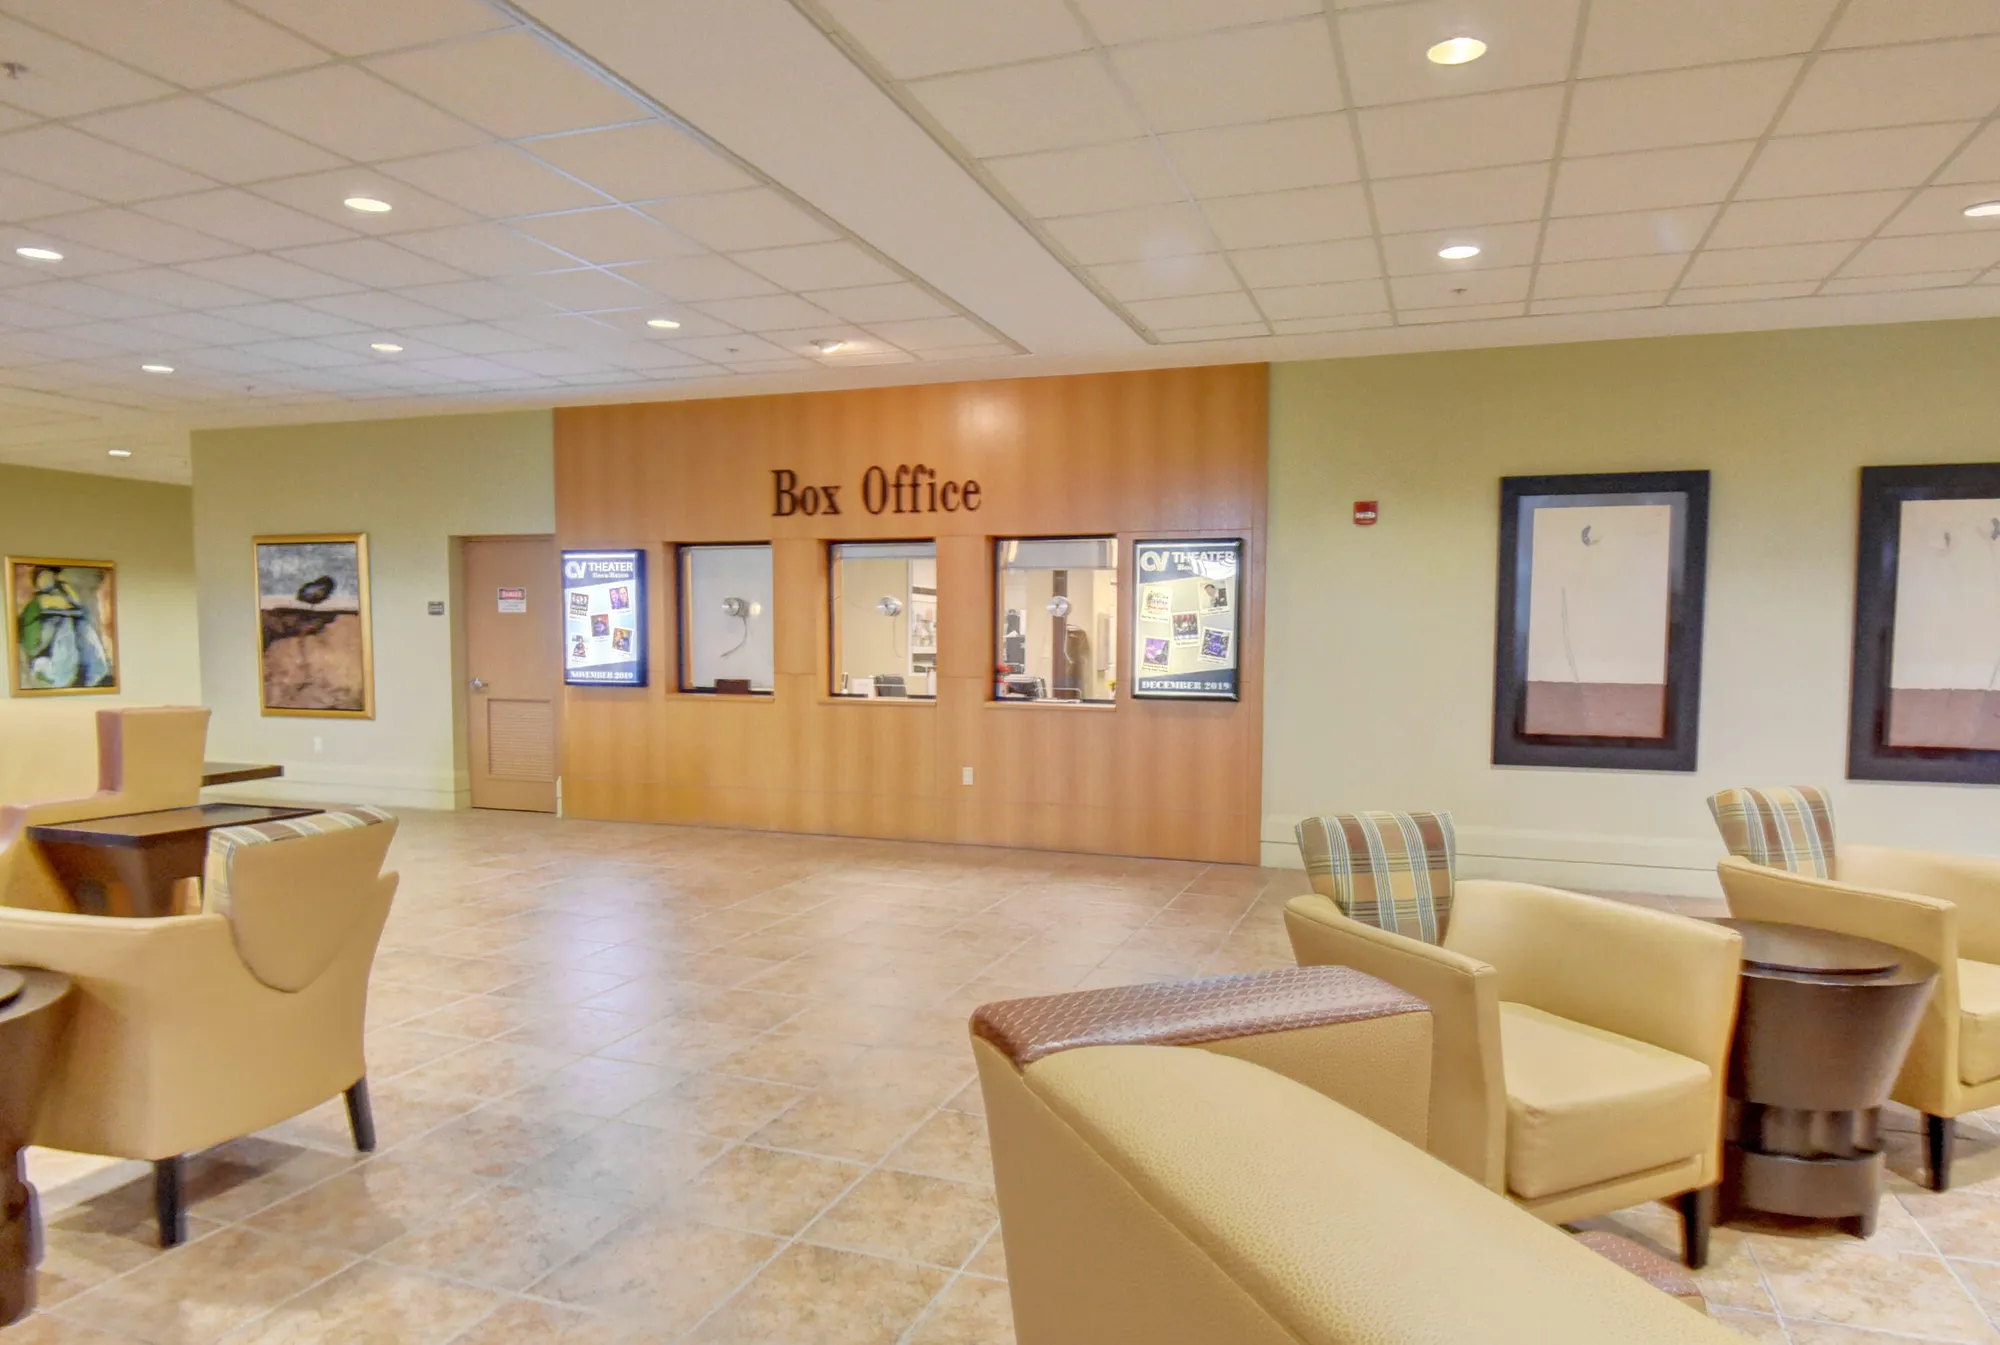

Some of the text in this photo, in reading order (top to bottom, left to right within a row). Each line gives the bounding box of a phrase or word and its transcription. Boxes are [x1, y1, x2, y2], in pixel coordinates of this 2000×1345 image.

[771, 464, 982, 517] Box Office
[1140, 550, 1171, 572] CV
[1172, 551, 1235, 563] THEATER
[565, 560, 587, 579] CV
[588, 561, 633, 572] THEATER
[570, 671, 634, 679] NOVEMBER 2019
[1142, 680, 1232, 690] DECEMBER 2019
